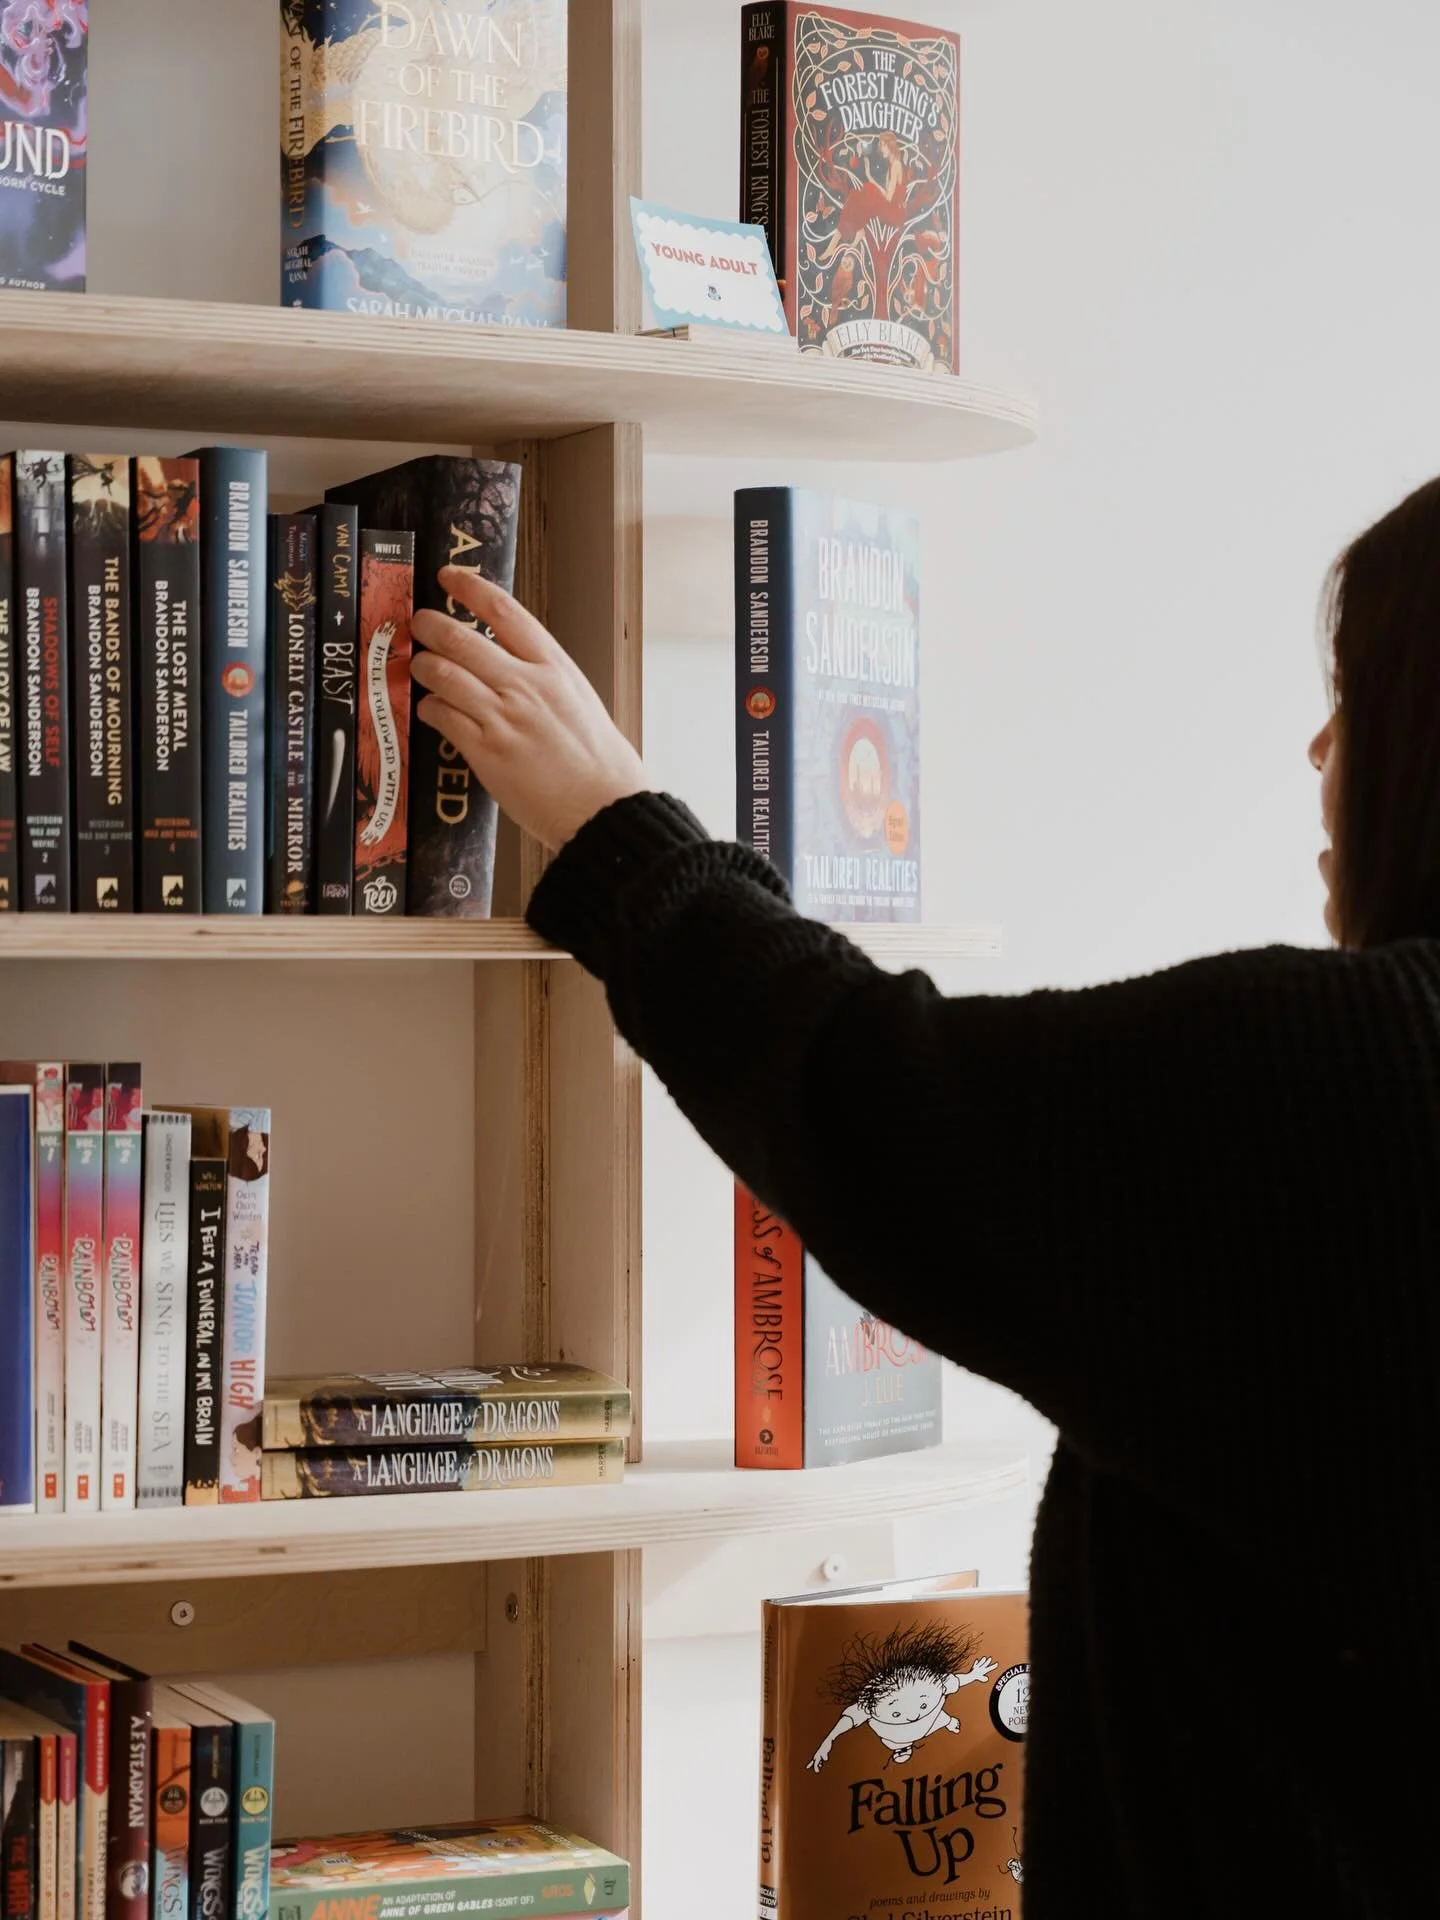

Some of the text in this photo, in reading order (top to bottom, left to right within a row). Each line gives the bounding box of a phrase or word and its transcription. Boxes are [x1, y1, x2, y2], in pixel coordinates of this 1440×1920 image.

[380, 1, 525, 68] DAWN
[749, 25, 774, 41] BLAKE
[752, 12, 771, 27] ELLY
[290, 46, 301, 71] OF
[872, 51, 897, 73] THE
[290, 75, 301, 110] THE
[400, 63, 507, 108] OF THE
[820, 72, 941, 127] FOREST KING'S
[356, 100, 544, 174] FIREBIRD
[840, 101, 923, 144] DAUGHTER
[288, 115, 304, 229] FIREBIRD
[751, 89, 769, 225] THE FOREST KING'S
[29, 181, 65, 196] CYCLE
[651, 242, 757, 275] YOUNG ADULT
[346, 297, 409, 319] SARAH
[836, 322, 871, 348] ELLY
[227, 481, 250, 648] BRANDON SANDERSON
[332, 523, 351, 598] VAN CAMP
[375, 543, 401, 555] WHITE
[818, 537, 904, 613] BRANDON
[750, 519, 768, 674] BRANDON SANDERSON
[805, 611, 915, 688] SANDERSON
[26, 587, 41, 777] BRANDON SANDERSON
[43, 597, 60, 767] SHADOWS OF SELF
[88, 585, 103, 776] BRANDON SANDERSON
[104, 557, 122, 805] THE BANDS OF MOURNING
[155, 580, 169, 771] BRANDON SANDERSON
[173, 600, 187, 751] THE LOST METAL
[287, 613, 304, 761] LONELY CASTLE
[322, 643, 354, 715] BEAST
[371, 645, 396, 830] HELL FOLLOWED WITH US
[228, 709, 248, 851] TAILORED REALITIES
[752, 731, 769, 792] TAILORED
[287, 797, 303, 873] MIRROR
[42, 852, 48, 863] 2
[804, 855, 918, 892] TAILORED REALITIES
[47, 1148, 54, 1162] 1
[81, 1149, 92, 1164] 2
[120, 1149, 131, 1164] 2
[155, 1202, 175, 1243] LIES
[200, 1207, 221, 1222] I
[200, 1225, 217, 1258] FELT
[233, 1245, 243, 1270] SARA
[249, 1242, 260, 1275] TEGAN
[160, 1251, 174, 1275] WE
[197, 1261, 214, 1275] A
[155, 1281, 174, 1336] SING
[752, 1246, 783, 1400] of AMBROSE
[158, 1343, 170, 1362] TO
[197, 1352, 212, 1369] IN
[229, 1279, 258, 1410] JUNIOR HIGH
[157, 1370, 170, 1404] THE
[196, 1372, 213, 1391] MY
[152, 1411, 173, 1452] SEA
[195, 1396, 215, 1446] BRAIN
[357, 1400, 560, 1438] A LANGUAGE of DRAGONS
[353, 1447, 553, 1486] A LANGUAGE of DRAGONS
[995, 1664, 1025, 1692] SPECIAL
[1016, 1687, 1031, 1704] 12
[1008, 1717, 1028, 1726] POE
[128, 1743, 146, 1828] STEADMAN
[847, 1763, 1006, 1834] Falling
[893, 1826, 974, 1884] Up
[162, 1845, 187, 1913] WINGS
[202, 1843, 229, 1916] WINGS
[243, 1842, 268, 1916] WINGS
[383, 1890, 456, 1905] AN ADAPTATION OF
[870, 1888, 991, 1910] poems and drawings by
[309, 1893, 381, 1920] ANNE
[380, 1895, 534, 1918] ANNE OF GREEN GABLES (SORT OF)
